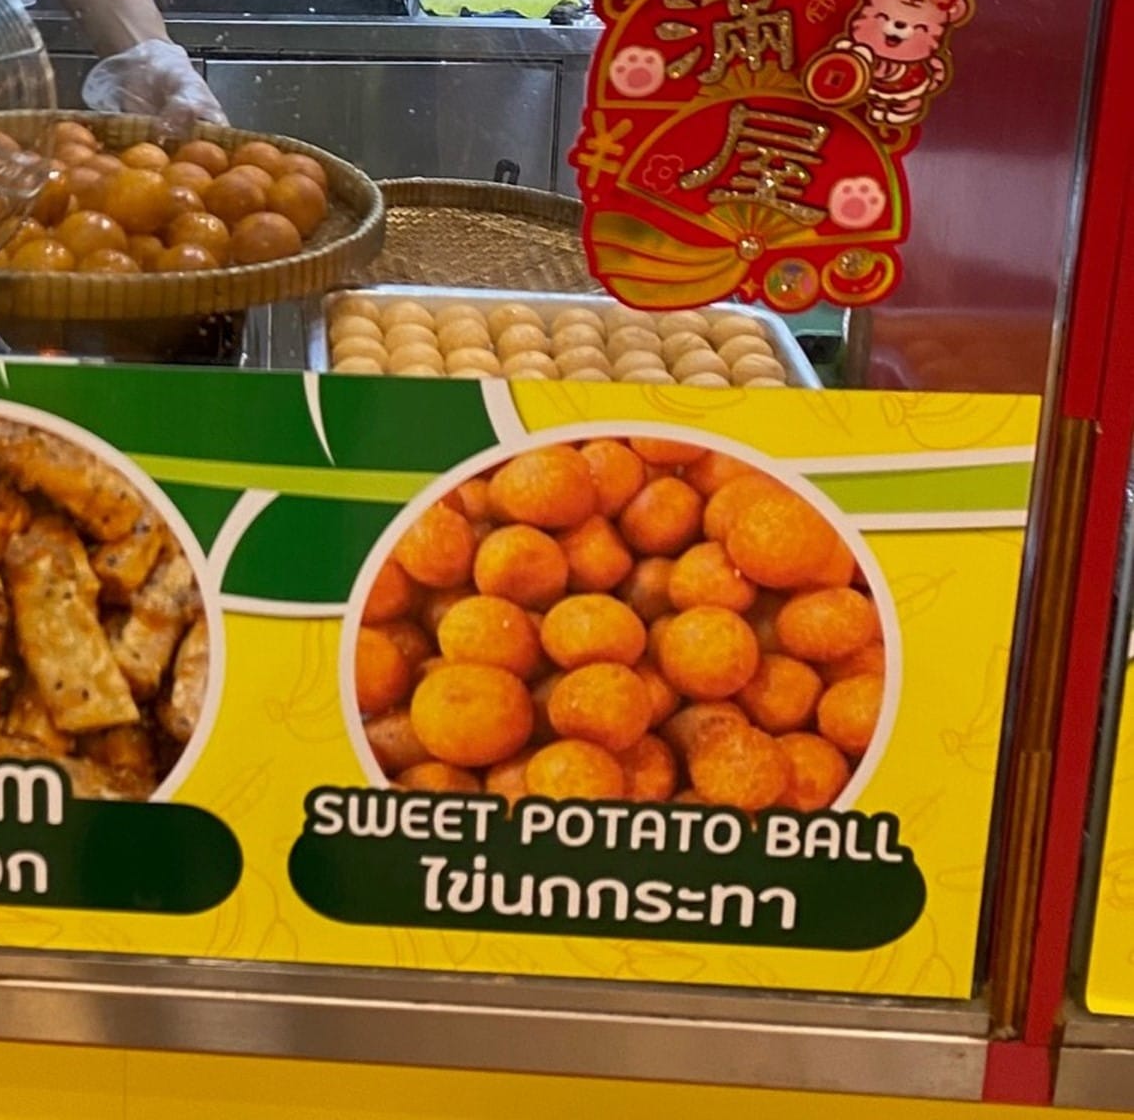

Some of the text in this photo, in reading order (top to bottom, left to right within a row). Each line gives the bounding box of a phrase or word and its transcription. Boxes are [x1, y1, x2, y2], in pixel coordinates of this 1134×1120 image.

[312, 793, 904, 863] SWEET POTATO BALL
[419, 854, 798, 930] ไข่นกกระทา
